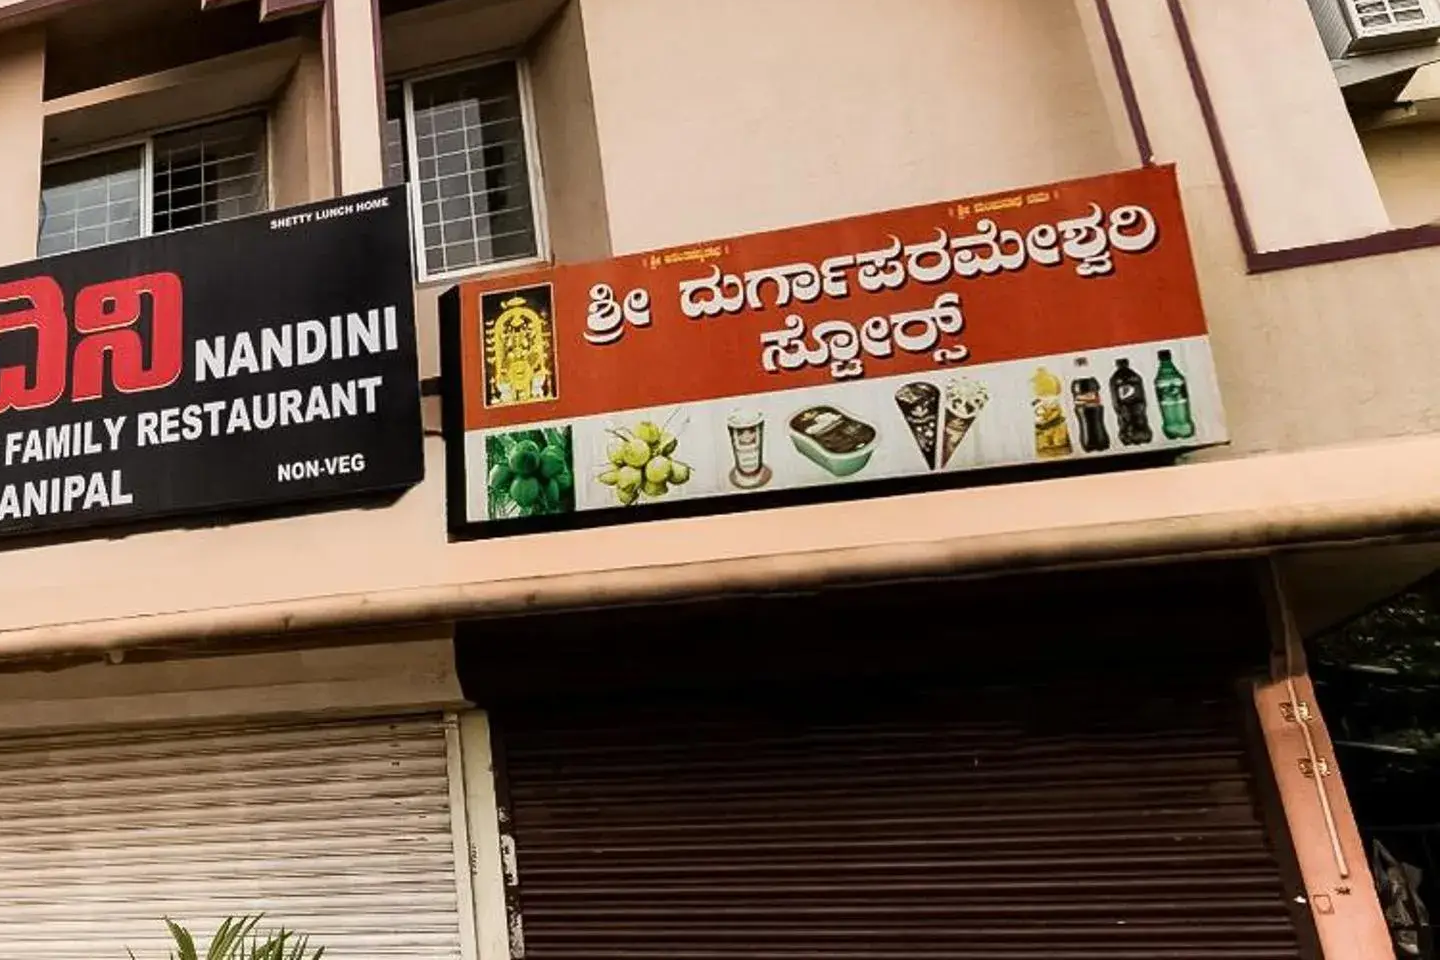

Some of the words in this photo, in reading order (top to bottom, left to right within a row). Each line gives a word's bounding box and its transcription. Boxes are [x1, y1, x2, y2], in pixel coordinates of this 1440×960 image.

[270, 212, 312, 230] SHETTY
[315, 205, 354, 221] LUNCH
[357, 197, 390, 213] HOME
[584, 281, 651, 343] ಶ್ರೀ
[194, 305, 399, 382] NANDINI
[5, 415, 128, 466] FAMILY
[136, 377, 383, 445] RESTAURANT
[277, 454, 365, 482] NON-VEG
